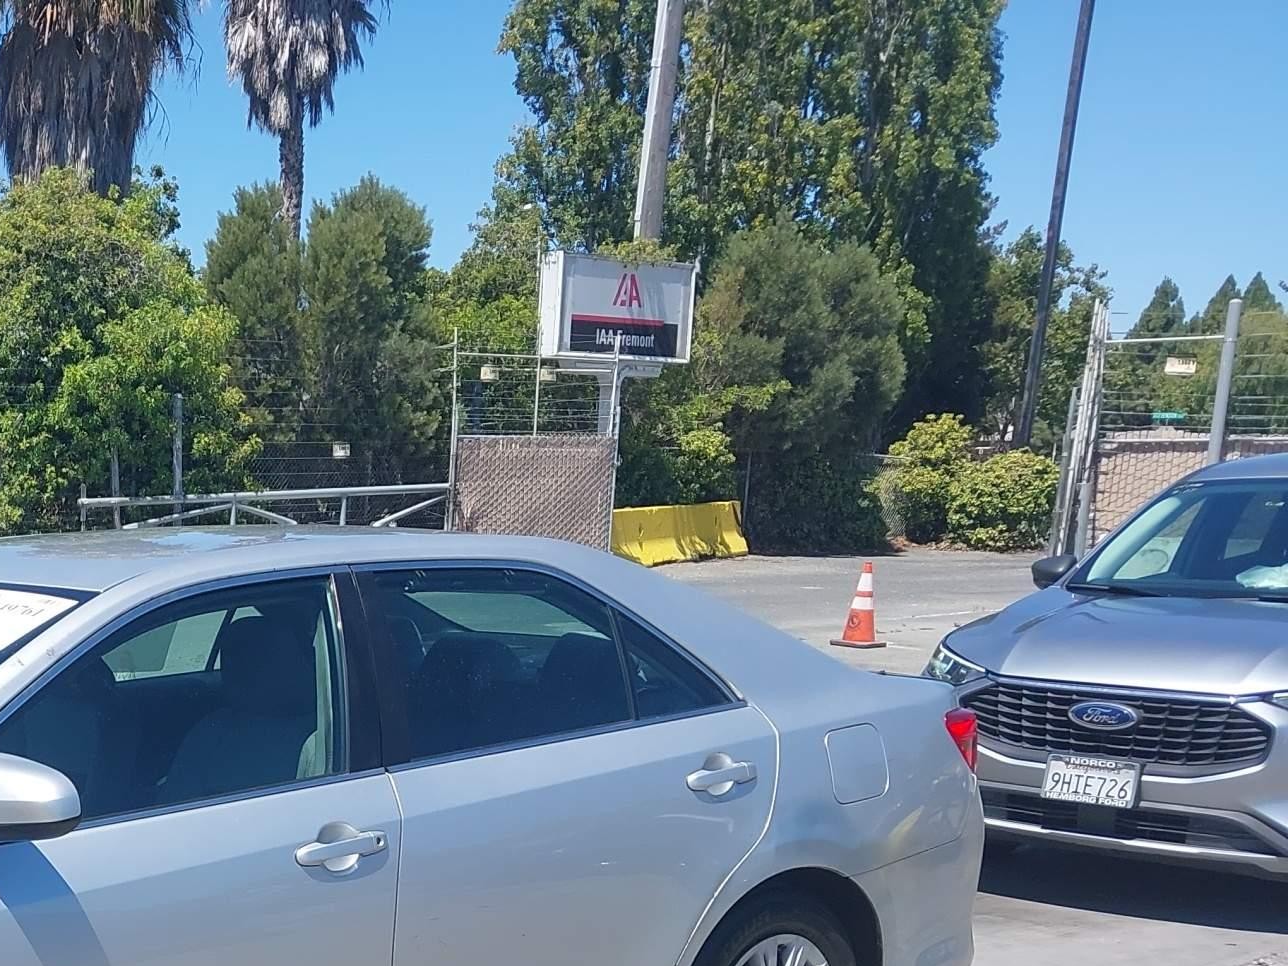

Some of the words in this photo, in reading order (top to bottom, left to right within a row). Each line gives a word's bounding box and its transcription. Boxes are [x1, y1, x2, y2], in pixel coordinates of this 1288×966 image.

[595, 328, 614, 345] IAA
[616, 330, 655, 347] Fremont
[1082, 707, 1121, 724] Ford
[1070, 757, 1116, 768] NORCO
[1049, 772, 1131, 800] 9HIE726
[1046, 791, 1096, 803] HEMBORG
[1098, 797, 1126, 807] FORD
